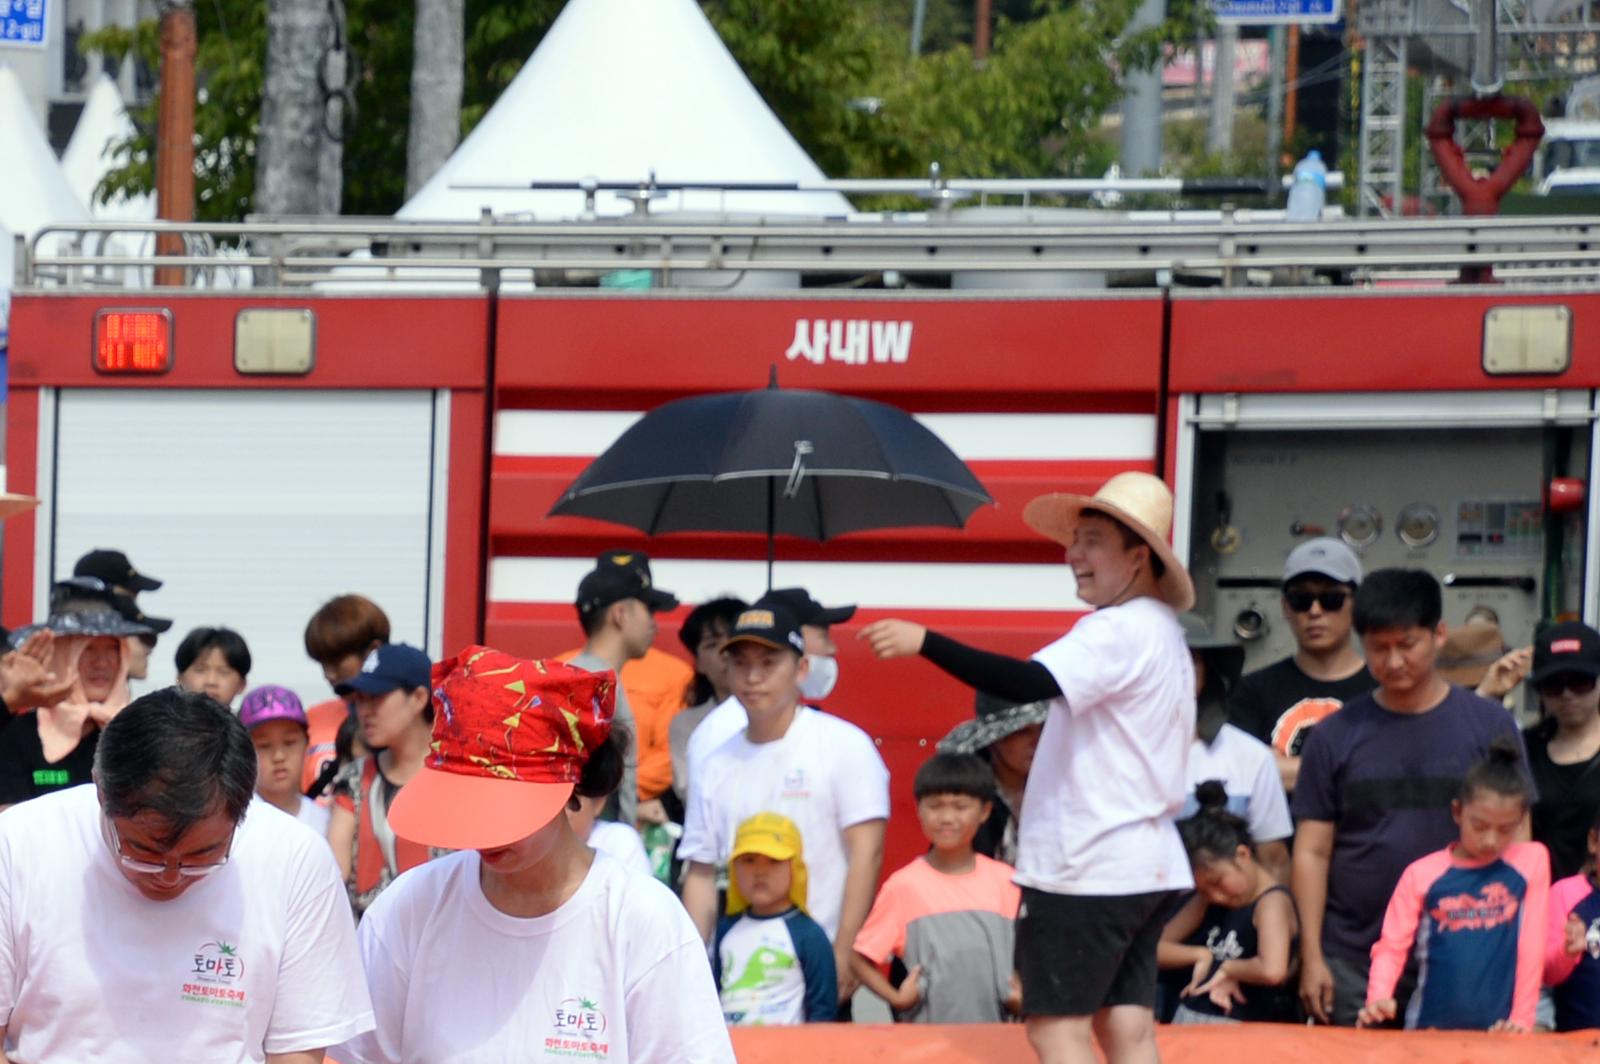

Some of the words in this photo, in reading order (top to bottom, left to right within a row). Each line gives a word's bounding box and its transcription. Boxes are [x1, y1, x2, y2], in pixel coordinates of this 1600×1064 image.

[6, 19, 41, 41] 2-gil
[785, 319, 914, 365] 사내W
[192, 954, 236, 977] 토마토
[553, 1009, 598, 1031] 토마토
